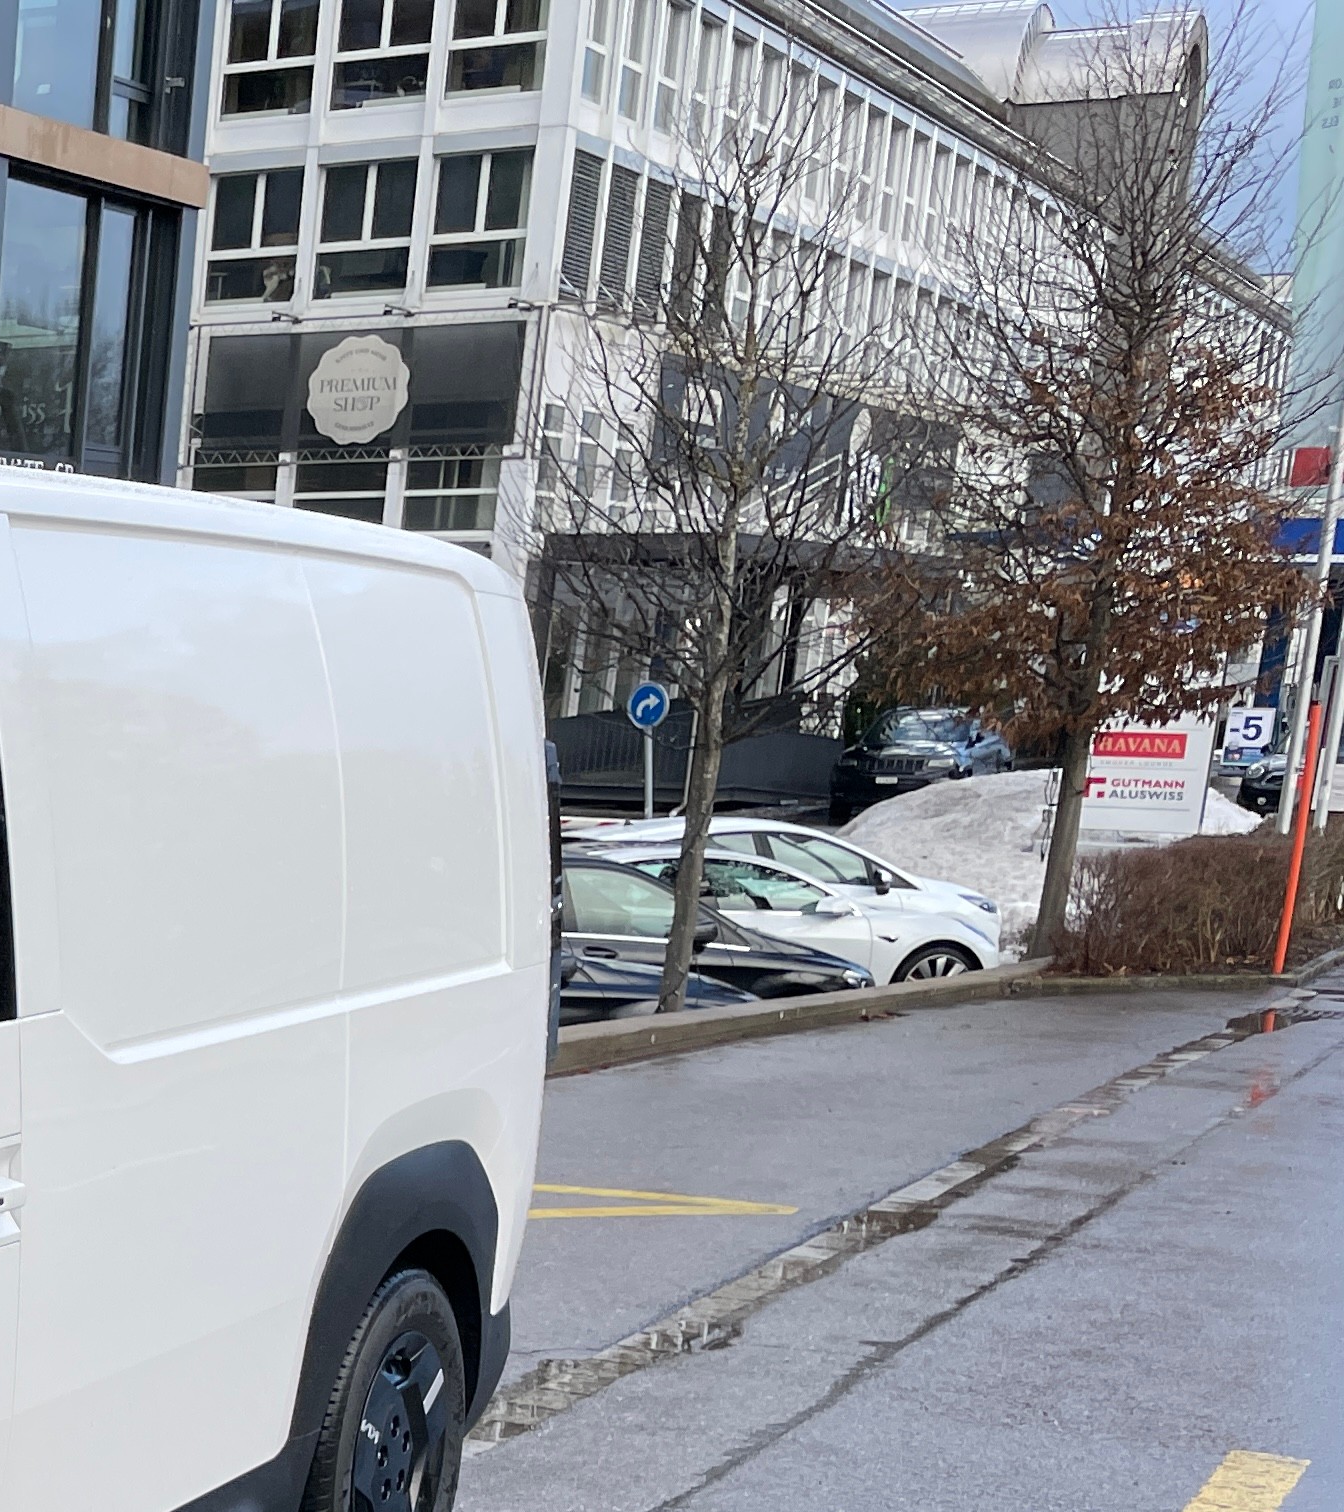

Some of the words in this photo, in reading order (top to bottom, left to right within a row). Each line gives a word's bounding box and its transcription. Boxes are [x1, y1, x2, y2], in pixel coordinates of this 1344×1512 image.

[319, 377, 397, 394] PREMIUM
[333, 396, 380, 412] SHOP
[1229, 716, 1263, 741] -5
[1098, 735, 1182, 754] HAVANA
[1111, 778, 1185, 789] GUTMANN
[1109, 790, 1183, 801] ALUSWISS
